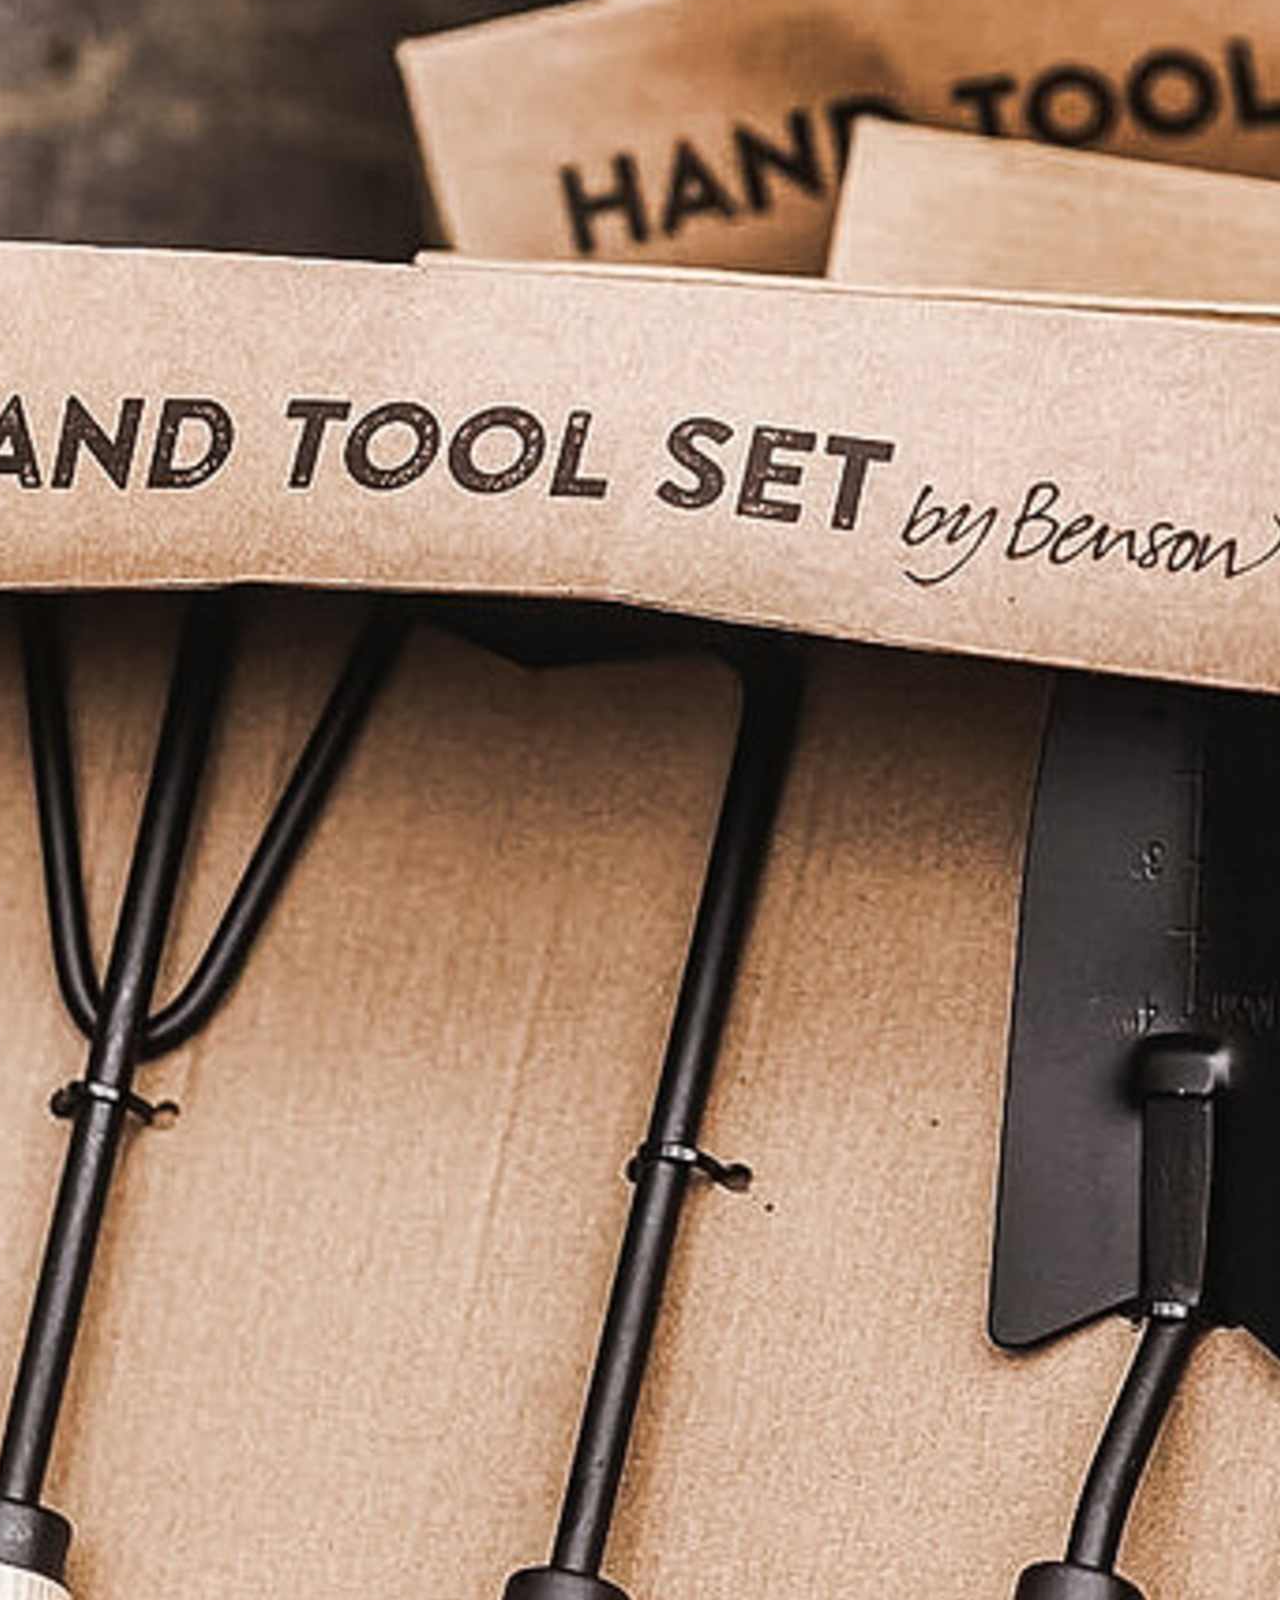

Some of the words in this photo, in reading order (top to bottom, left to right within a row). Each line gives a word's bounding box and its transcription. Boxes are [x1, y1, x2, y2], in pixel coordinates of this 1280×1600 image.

[284, 398, 611, 499] TOOL
[655, 416, 896, 531] SET
[900, 483, 998, 587] by
